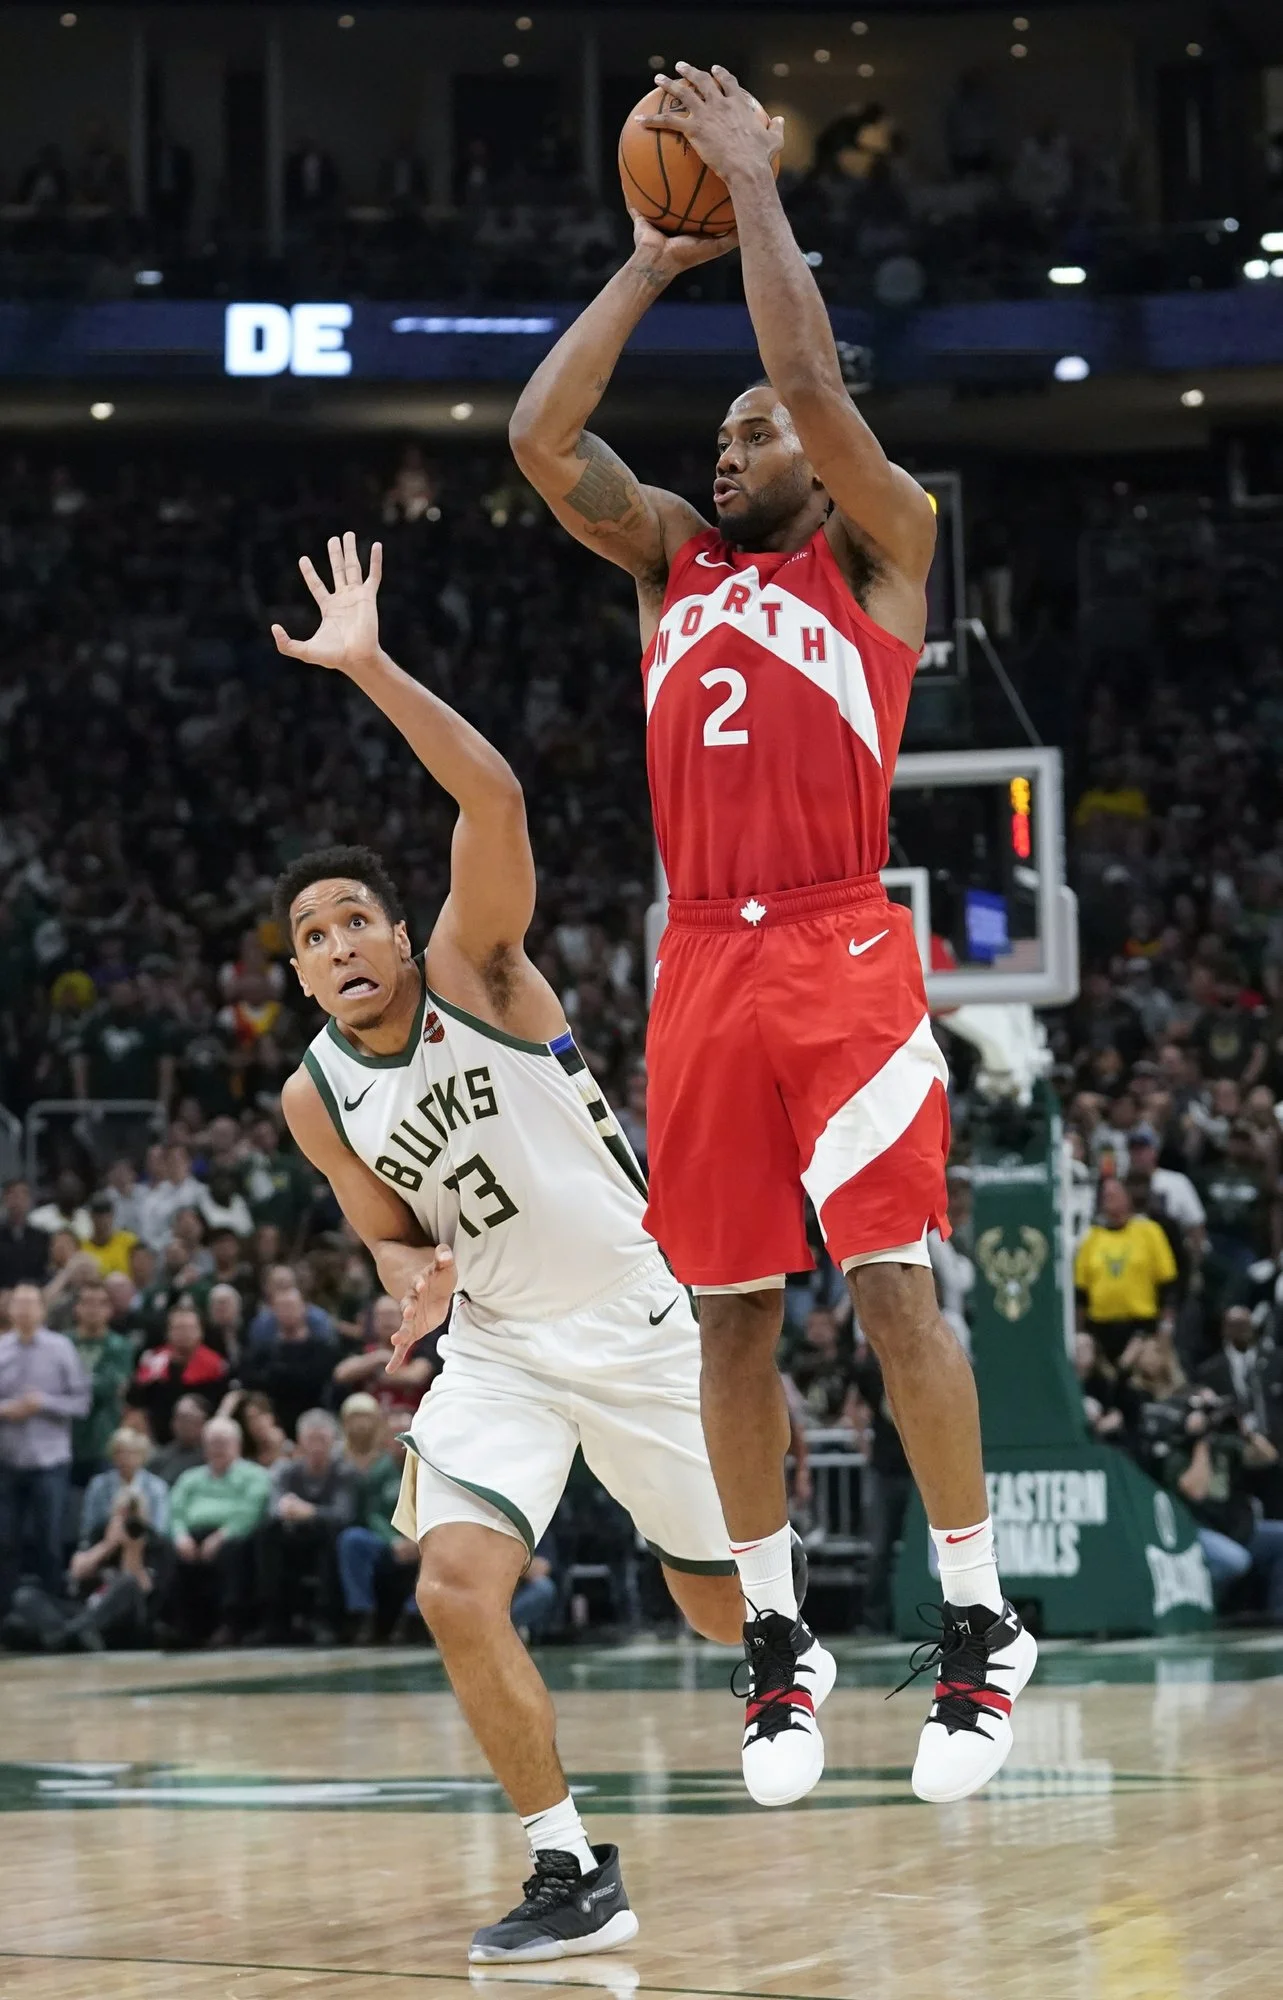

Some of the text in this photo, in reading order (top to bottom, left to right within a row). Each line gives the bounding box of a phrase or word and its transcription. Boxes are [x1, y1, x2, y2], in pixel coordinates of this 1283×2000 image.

[225, 303, 351, 376] DE
[654, 583, 828, 667] NORTH
[700, 667, 749, 746] 2
[375, 1066, 500, 1192] BUCKS
[443, 1153, 519, 1239] 13
[985, 1470, 1107, 1524] EASTERN
[994, 1521, 1080, 1576] INALS
